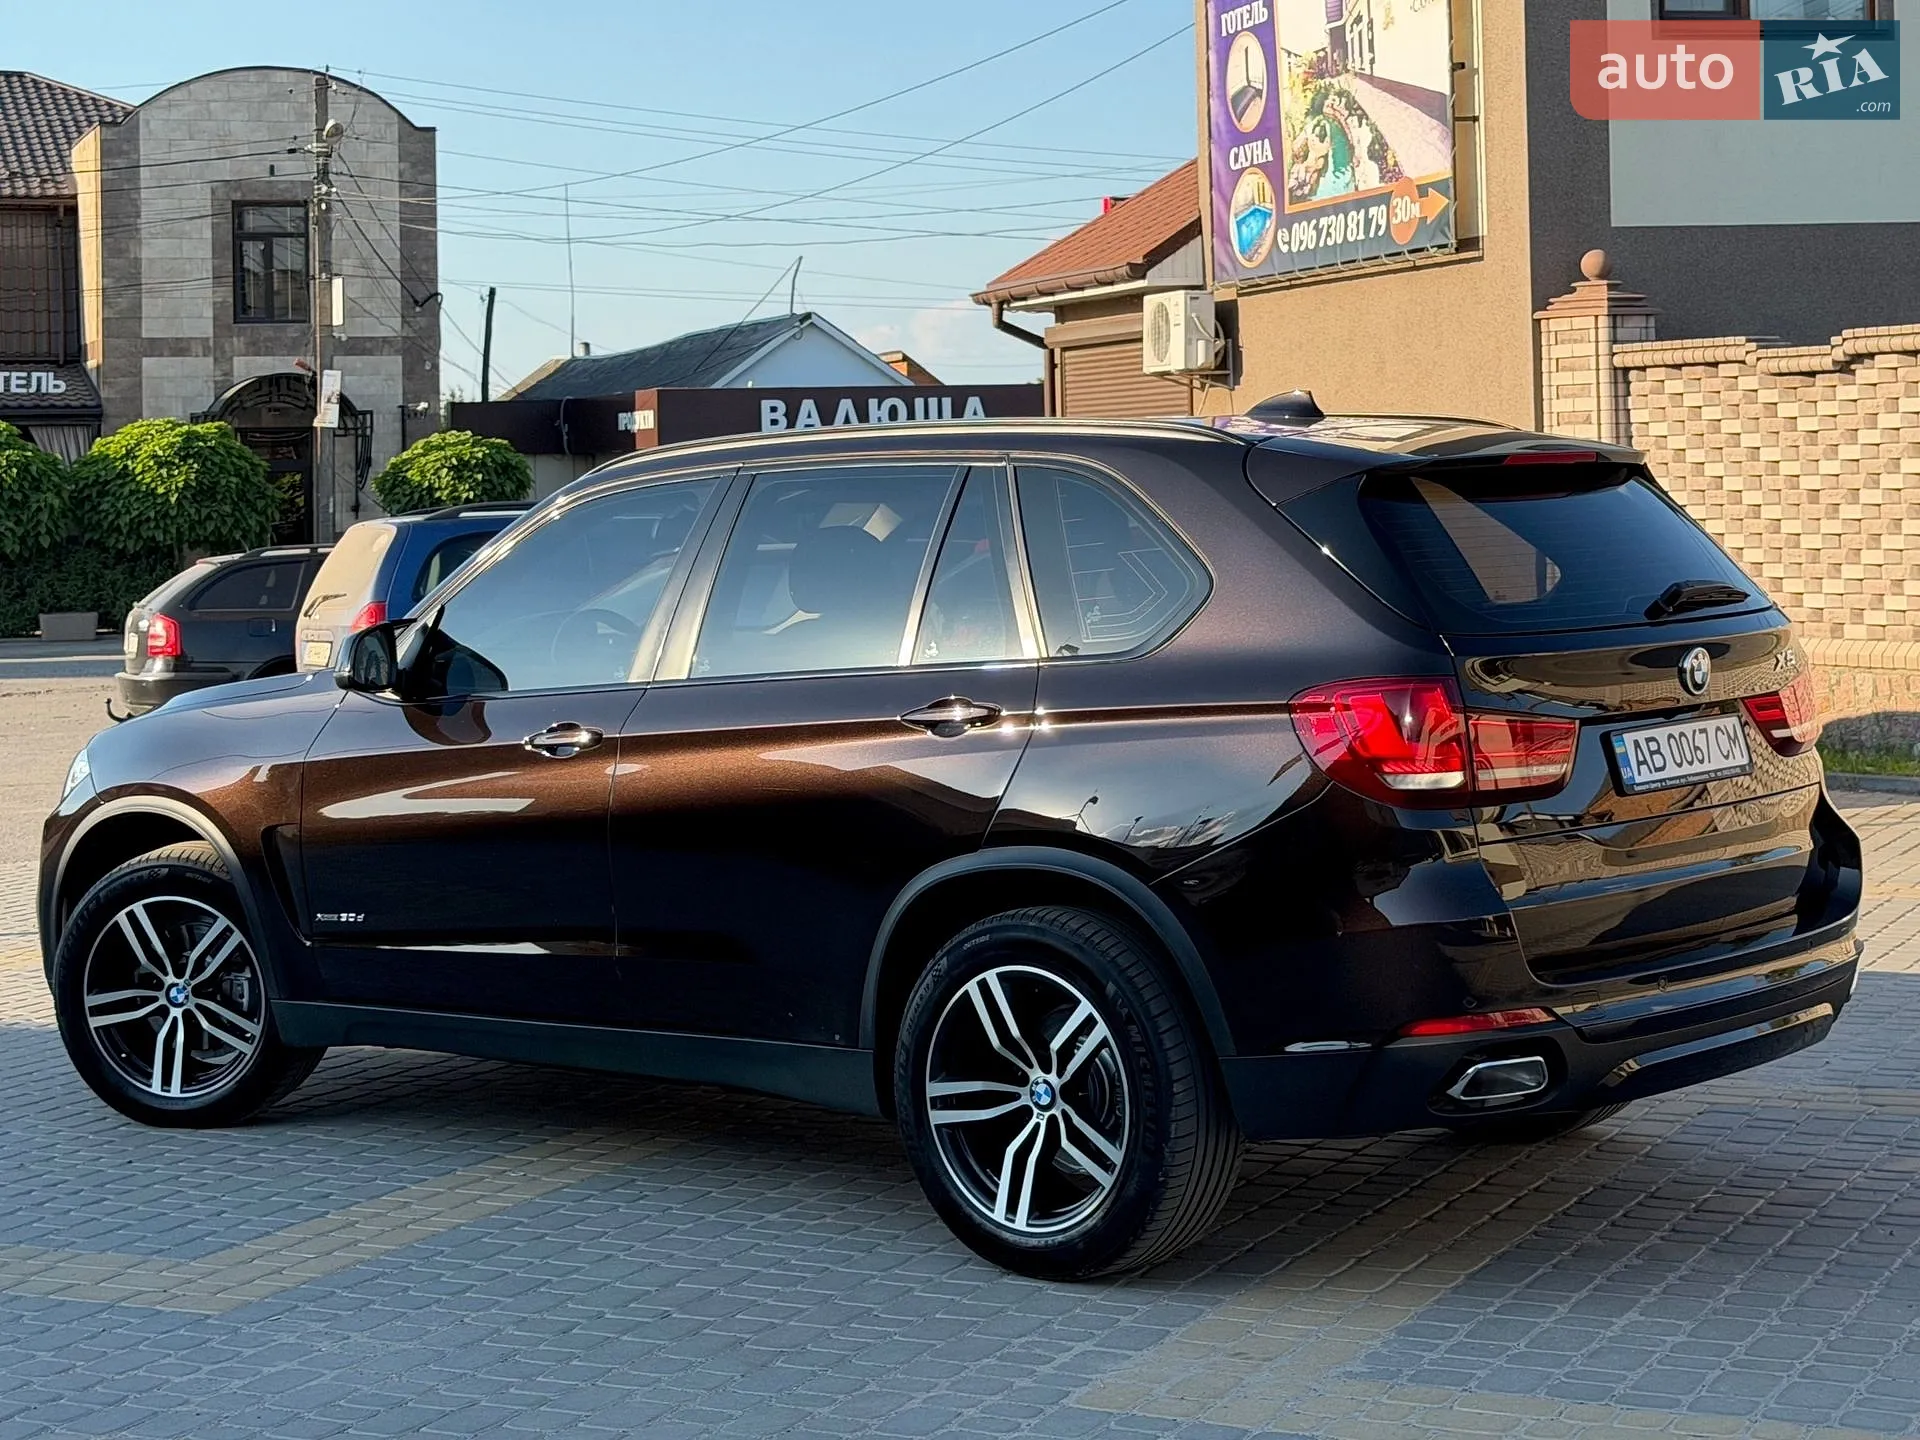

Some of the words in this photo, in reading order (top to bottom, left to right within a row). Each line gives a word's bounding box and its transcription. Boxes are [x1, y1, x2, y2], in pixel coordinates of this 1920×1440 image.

[1221, 0, 1268, 37] ГОТЕЛЬ
[1229, 138, 1273, 170] САУНА
[1290, 219, 1318, 253] 096
[1318, 213, 1345, 247] 730
[1346, 208, 1365, 242] 81
[1368, 204, 1387, 238] 79
[760, 396, 985, 433] ВАЛЮША
[1632, 736, 1667, 777] AB
[1667, 727, 1711, 769] 0067
[1715, 723, 1744, 760] CM
[1620, 766, 1633, 779] UA
